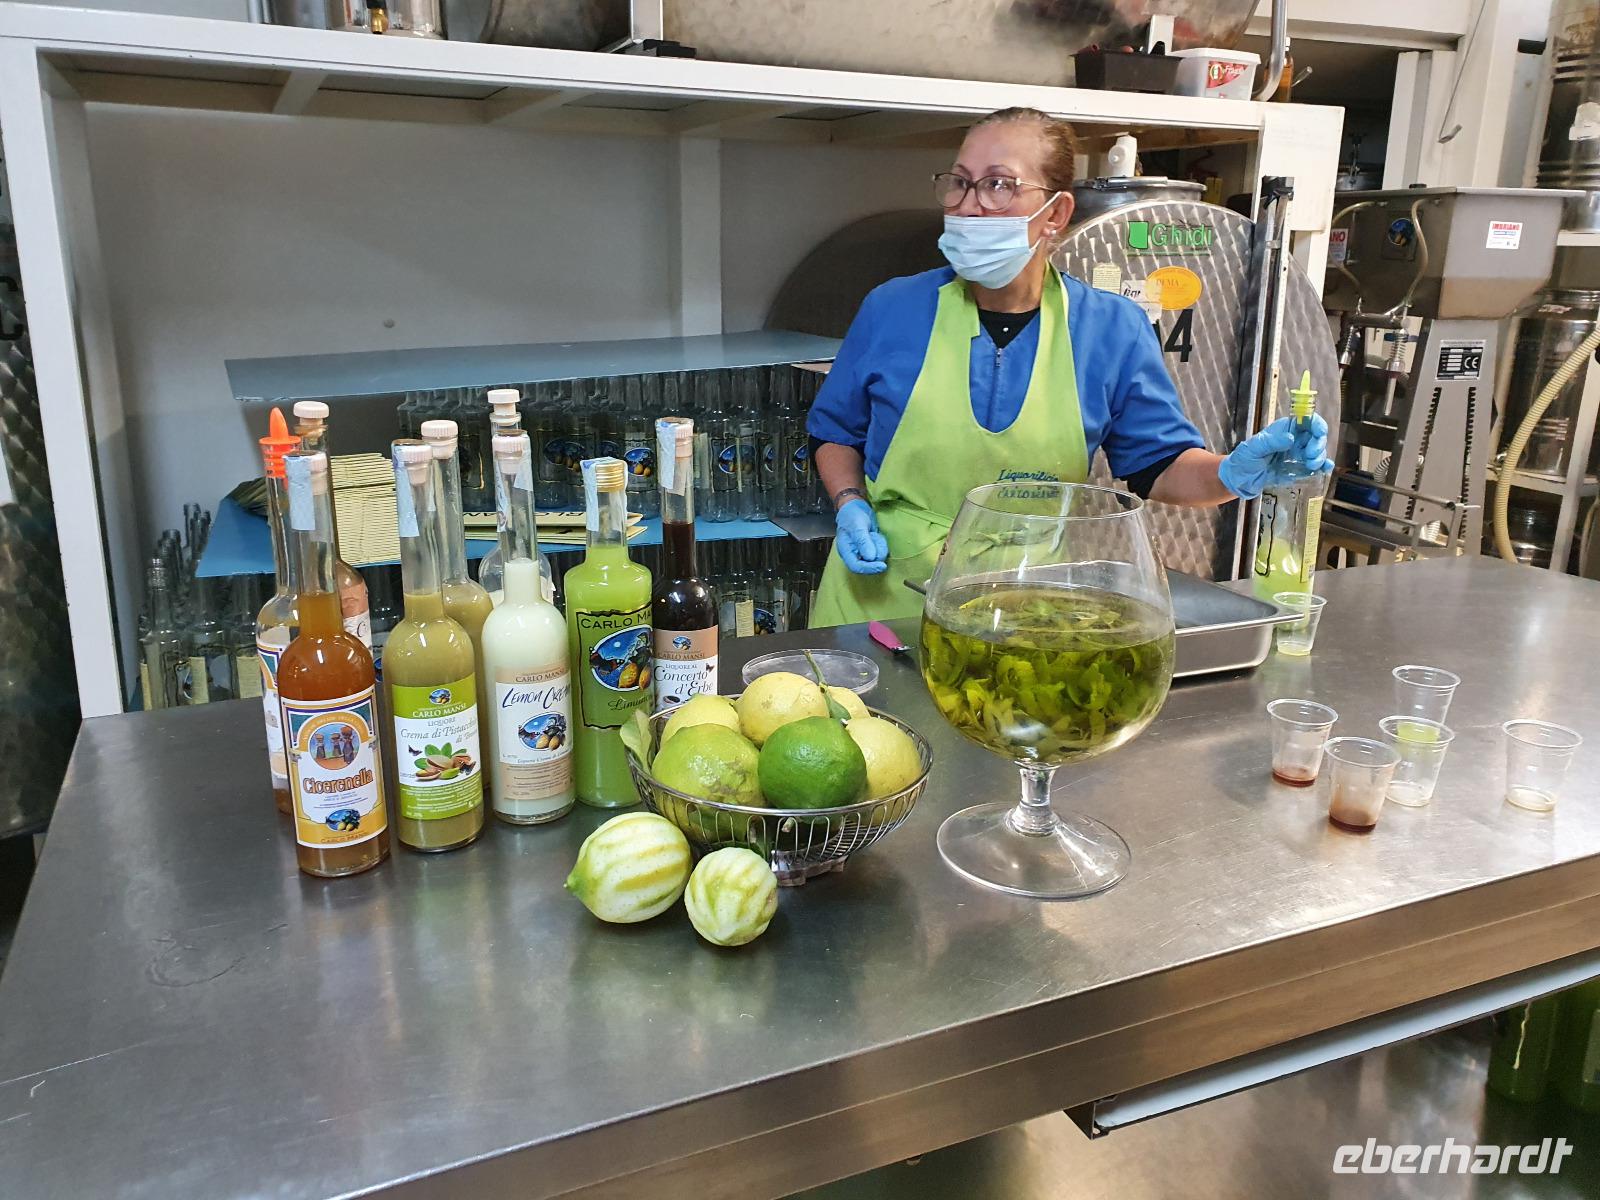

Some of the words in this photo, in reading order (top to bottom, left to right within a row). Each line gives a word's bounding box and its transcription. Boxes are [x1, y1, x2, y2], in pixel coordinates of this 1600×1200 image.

[1151, 223, 1213, 247] Ghidi
[580, 617, 632, 630] CARLO
[683, 652, 705, 660] MANSI
[515, 674, 543, 683] CARLO
[653, 665, 708, 682] Concerto
[412, 709, 441, 719] CARLO
[443, 702, 466, 714] MANSI
[400, 728, 430, 740] Crema
[431, 728, 441, 739] di
[303, 768, 374, 794] Cicerenella
